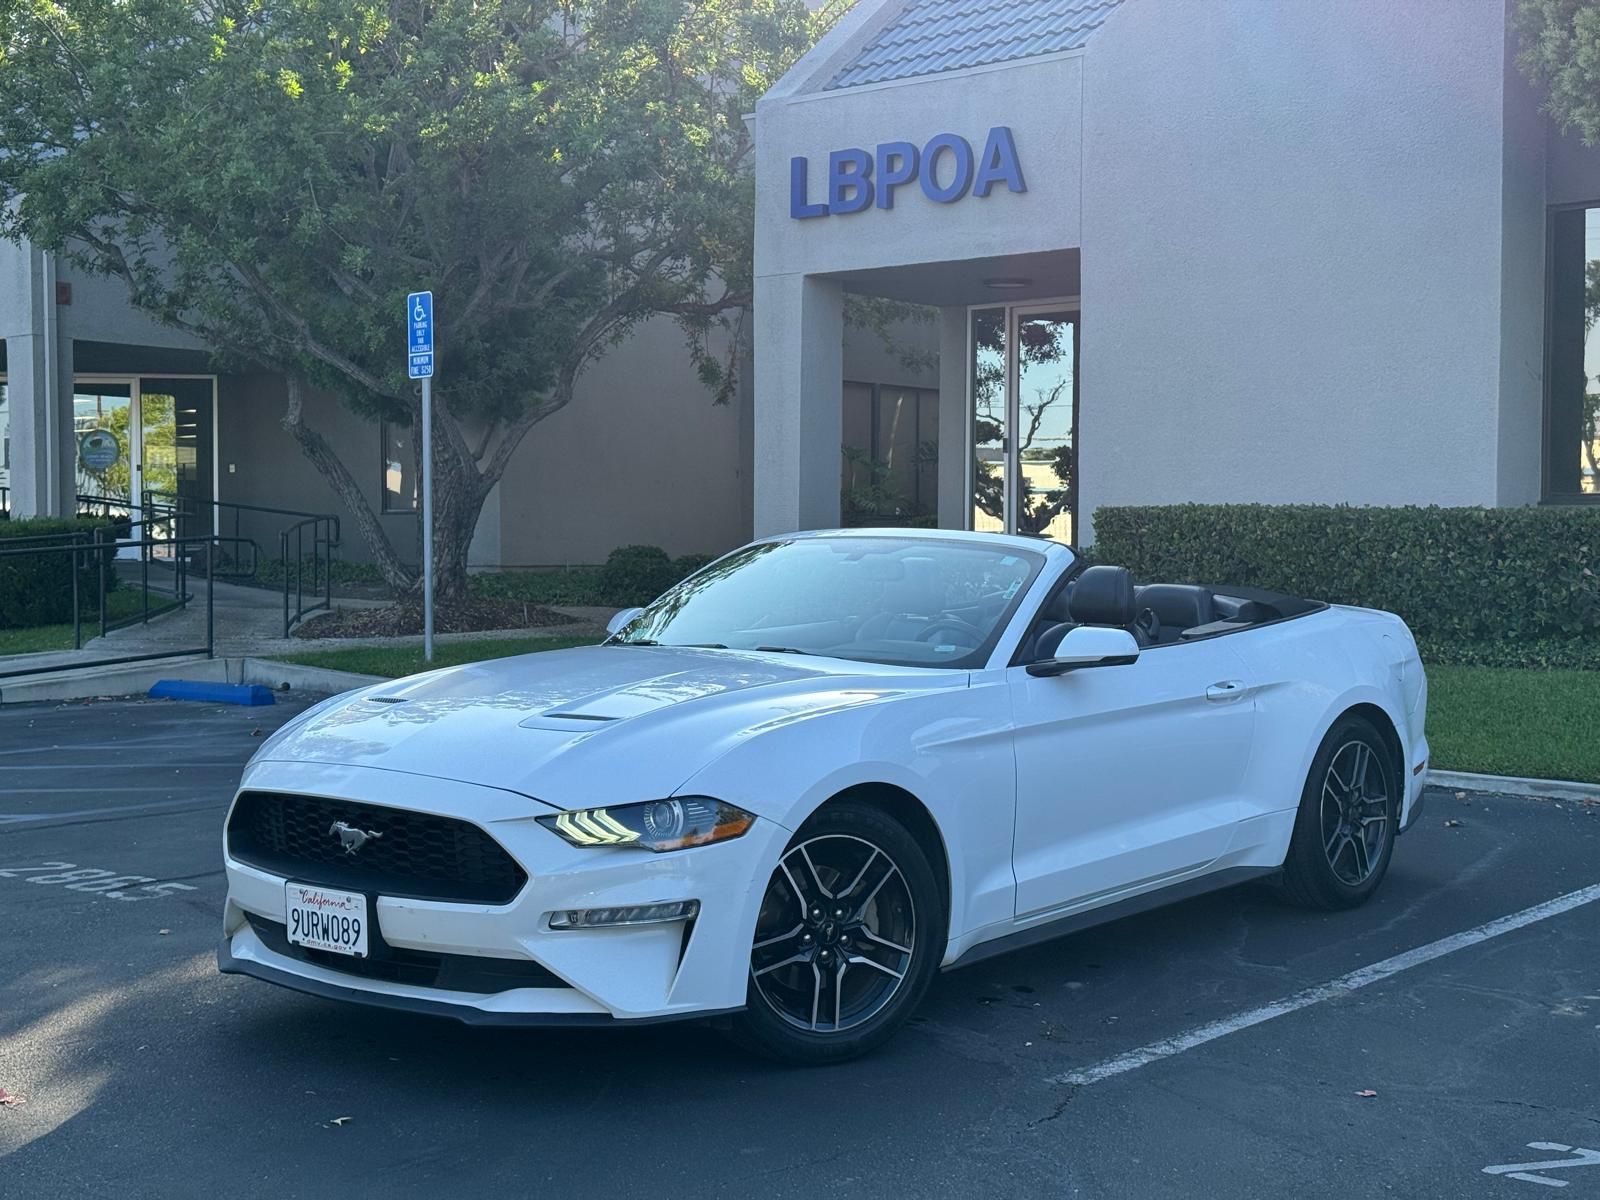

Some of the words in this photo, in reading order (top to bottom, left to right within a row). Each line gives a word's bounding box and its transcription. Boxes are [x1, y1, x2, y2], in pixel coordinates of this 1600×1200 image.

[791, 126, 1028, 219] LBPOA
[413, 356, 429, 365] MINIMUM
[411, 366, 419, 375] FINE
[421, 365, 431, 374] $250
[302, 889, 353, 910] California
[292, 908, 361, 946] 9URW089
[306, 939, 347, 951] dmv.ca.gov
